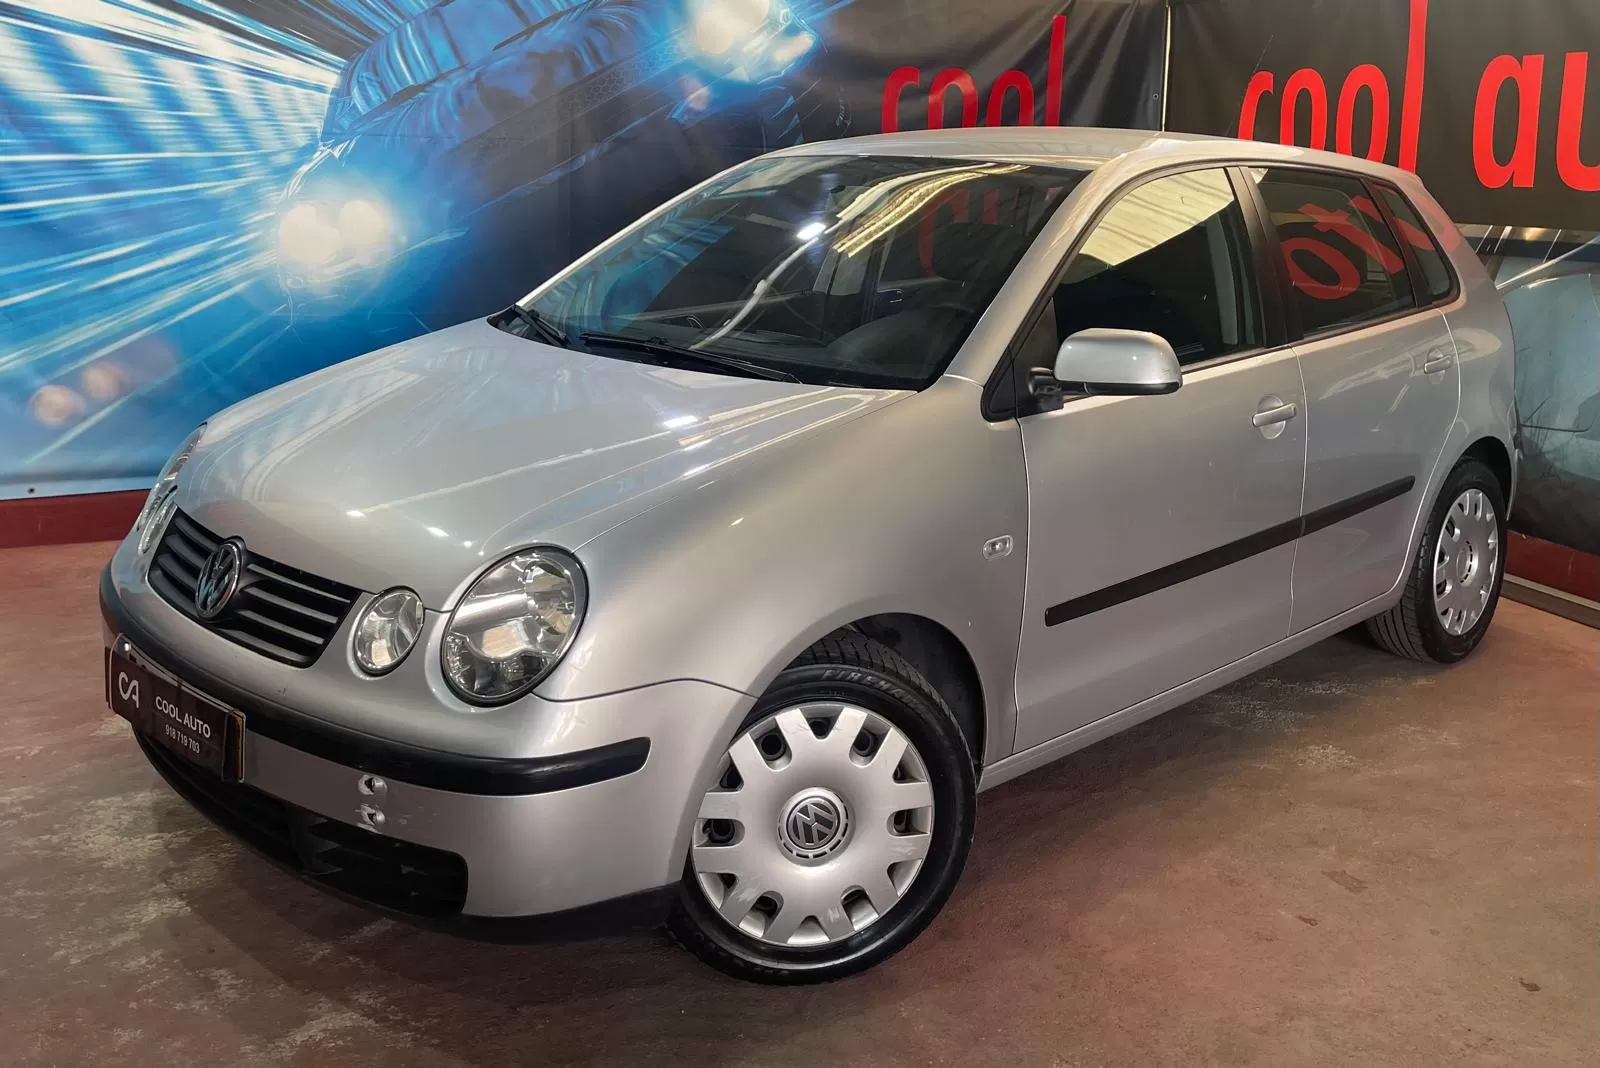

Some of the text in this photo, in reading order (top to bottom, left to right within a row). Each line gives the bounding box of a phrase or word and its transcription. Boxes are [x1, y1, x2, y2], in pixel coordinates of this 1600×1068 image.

[155, 695, 211, 738] COOL AUTO
[165, 723, 176, 740] 918
[177, 730, 188, 747] 719
